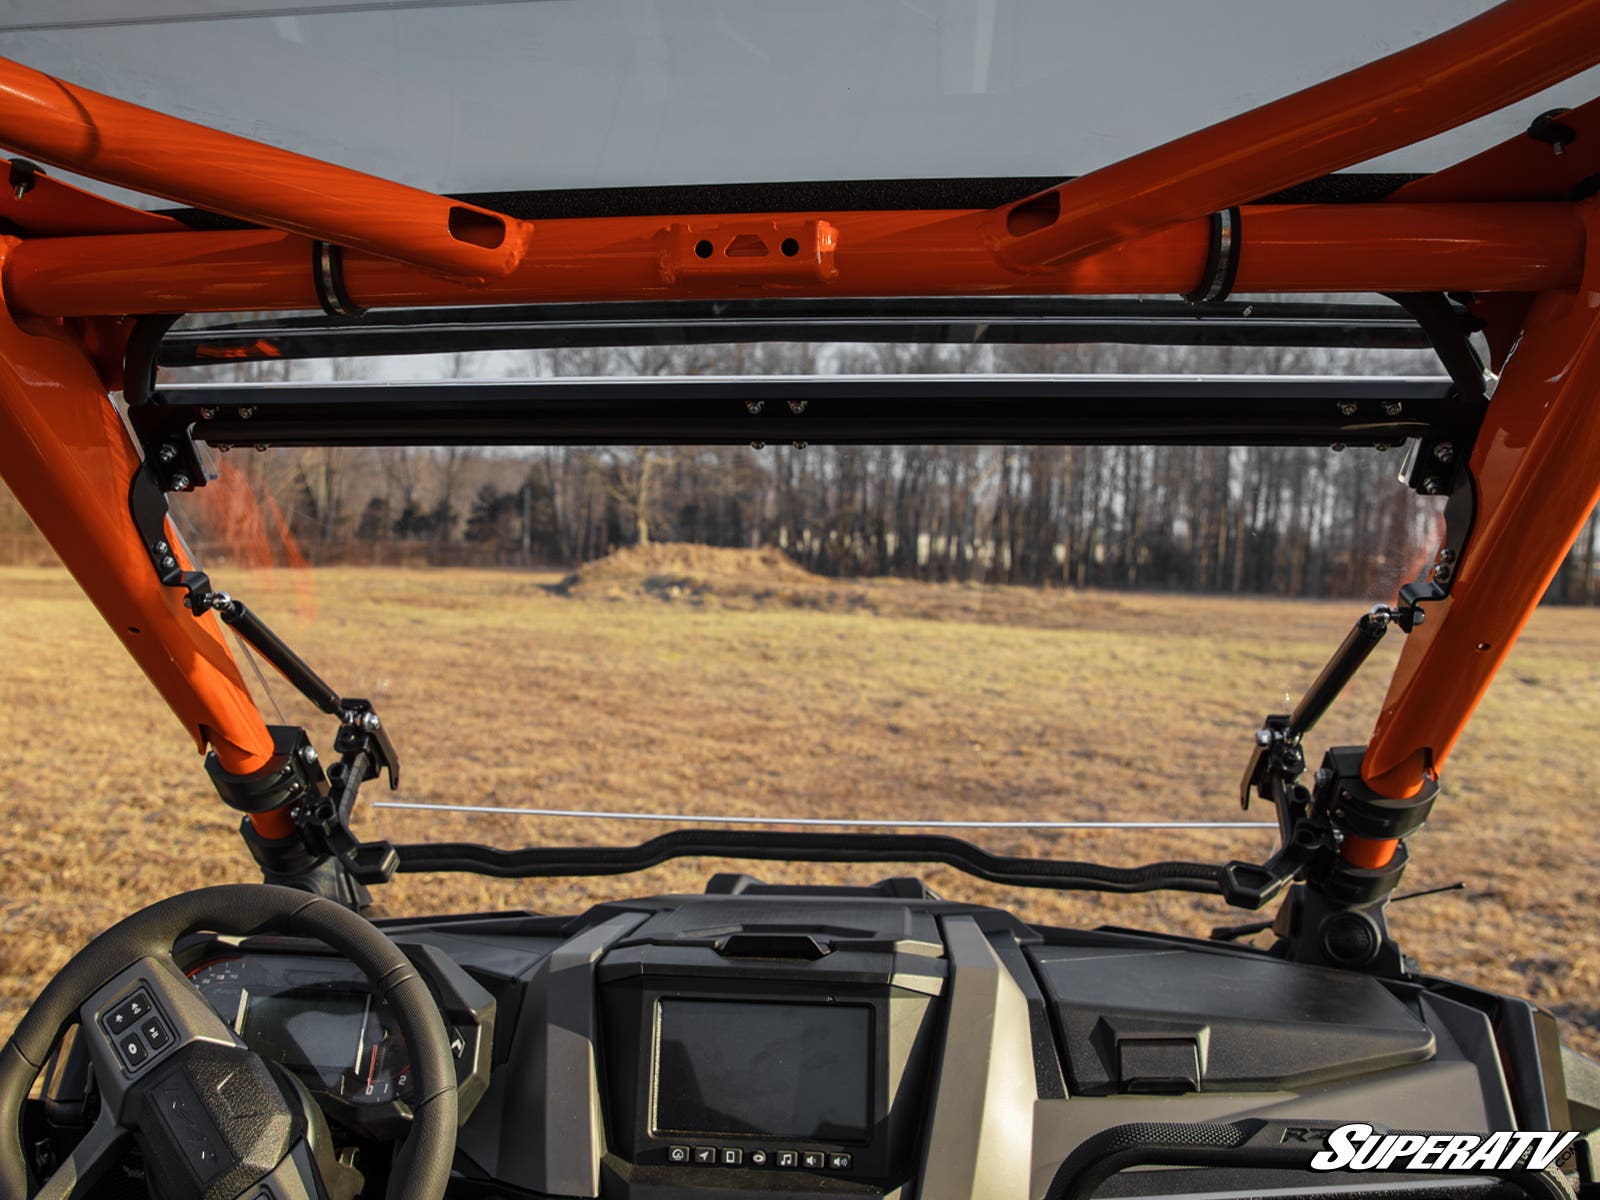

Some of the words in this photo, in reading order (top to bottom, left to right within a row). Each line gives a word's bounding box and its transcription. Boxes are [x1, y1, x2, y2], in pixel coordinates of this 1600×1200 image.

[365, 1085, 374, 1095] 0
[383, 1083, 389, 1094] 1
[398, 1075, 407, 1086] 2
[1279, 1127, 1331, 1144] RZ
